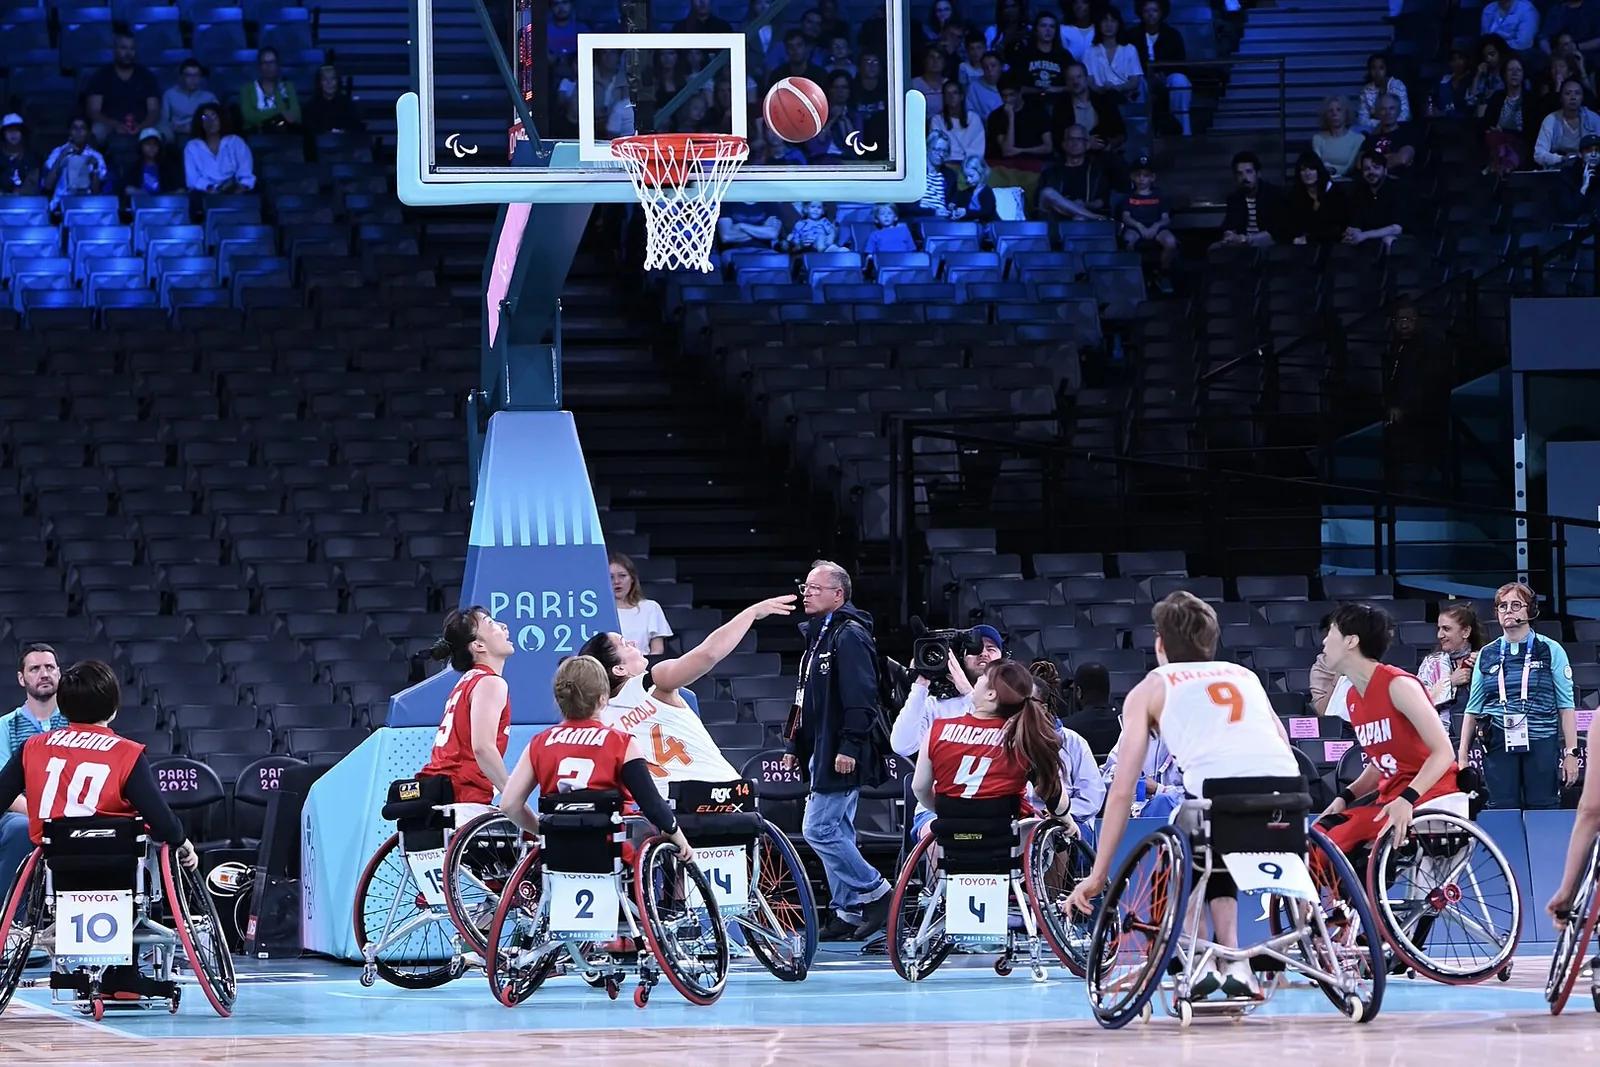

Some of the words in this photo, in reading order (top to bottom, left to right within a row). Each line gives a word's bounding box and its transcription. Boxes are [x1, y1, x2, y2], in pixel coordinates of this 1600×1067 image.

[1205, 681, 1246, 724] 9
[260, 779, 280, 790] 20
[556, 756, 596, 794] 2
[763, 771, 801, 782] 2024
[953, 754, 993, 799] 4
[38, 756, 111, 819] 10
[159, 780, 199, 792] 2024
[735, 783, 750, 797] 14
[696, 850, 735, 860] TOYOTA
[1258, 861, 1283, 880] 9
[959, 878, 998, 886] TOYOTA
[70, 894, 119, 902] TOYOTA
[574, 888, 595, 919] 2
[968, 895, 986, 923] 4
[70, 912, 119, 943] 10
